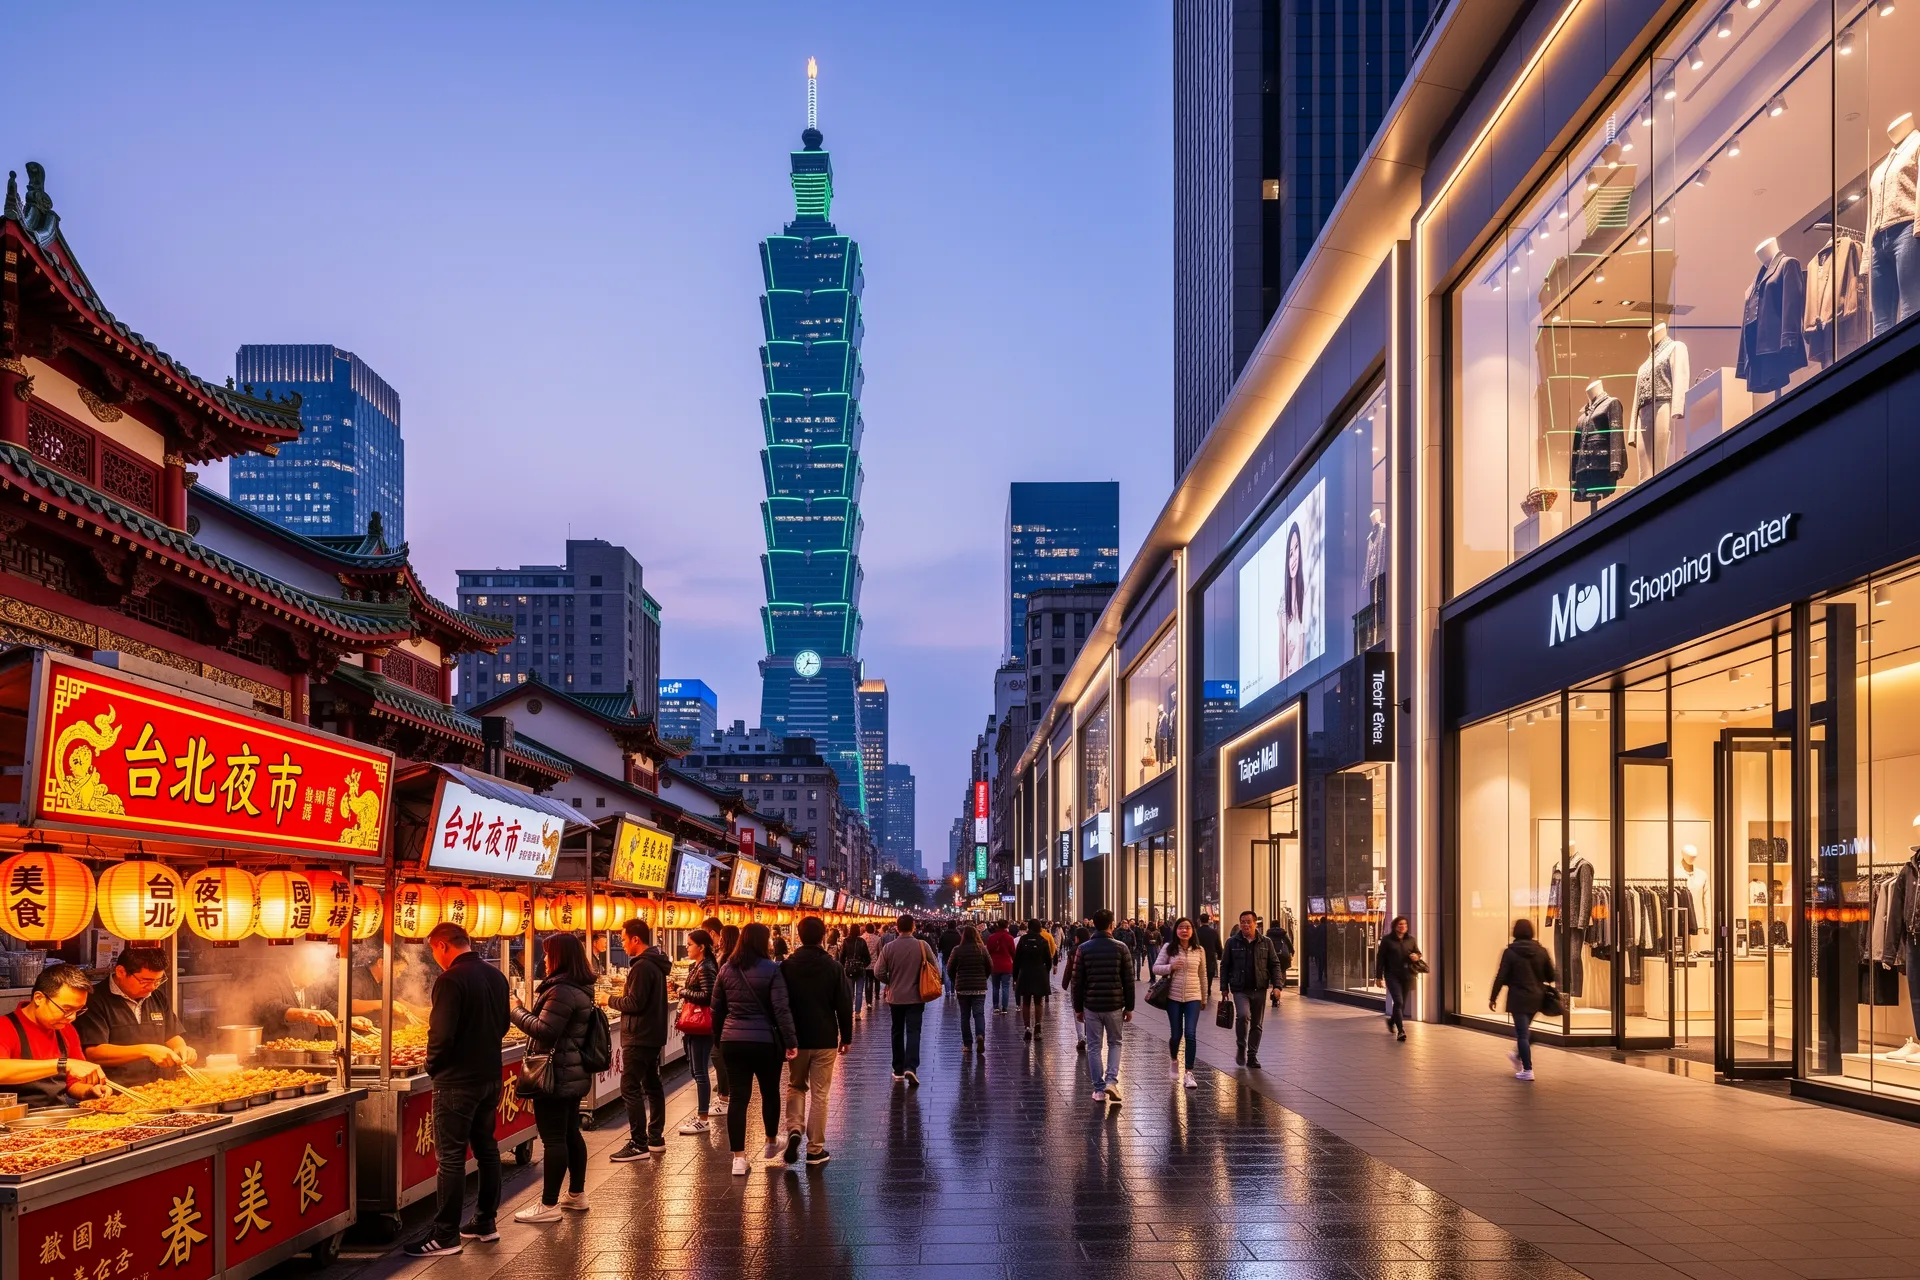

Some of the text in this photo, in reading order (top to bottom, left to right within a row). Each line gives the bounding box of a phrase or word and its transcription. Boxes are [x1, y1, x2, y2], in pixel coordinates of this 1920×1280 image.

[1629, 551, 1712, 609] Shopping
[1717, 512, 1793, 566] Center
[124, 722, 303, 826] 台北夜市
[1238, 741, 1279, 784] Taipei Mall
[443, 804, 522, 862] 台北夜市
[9, 864, 47, 929] 美食
[144, 873, 176, 928] 台北
[194, 876, 223, 931] 夜市
